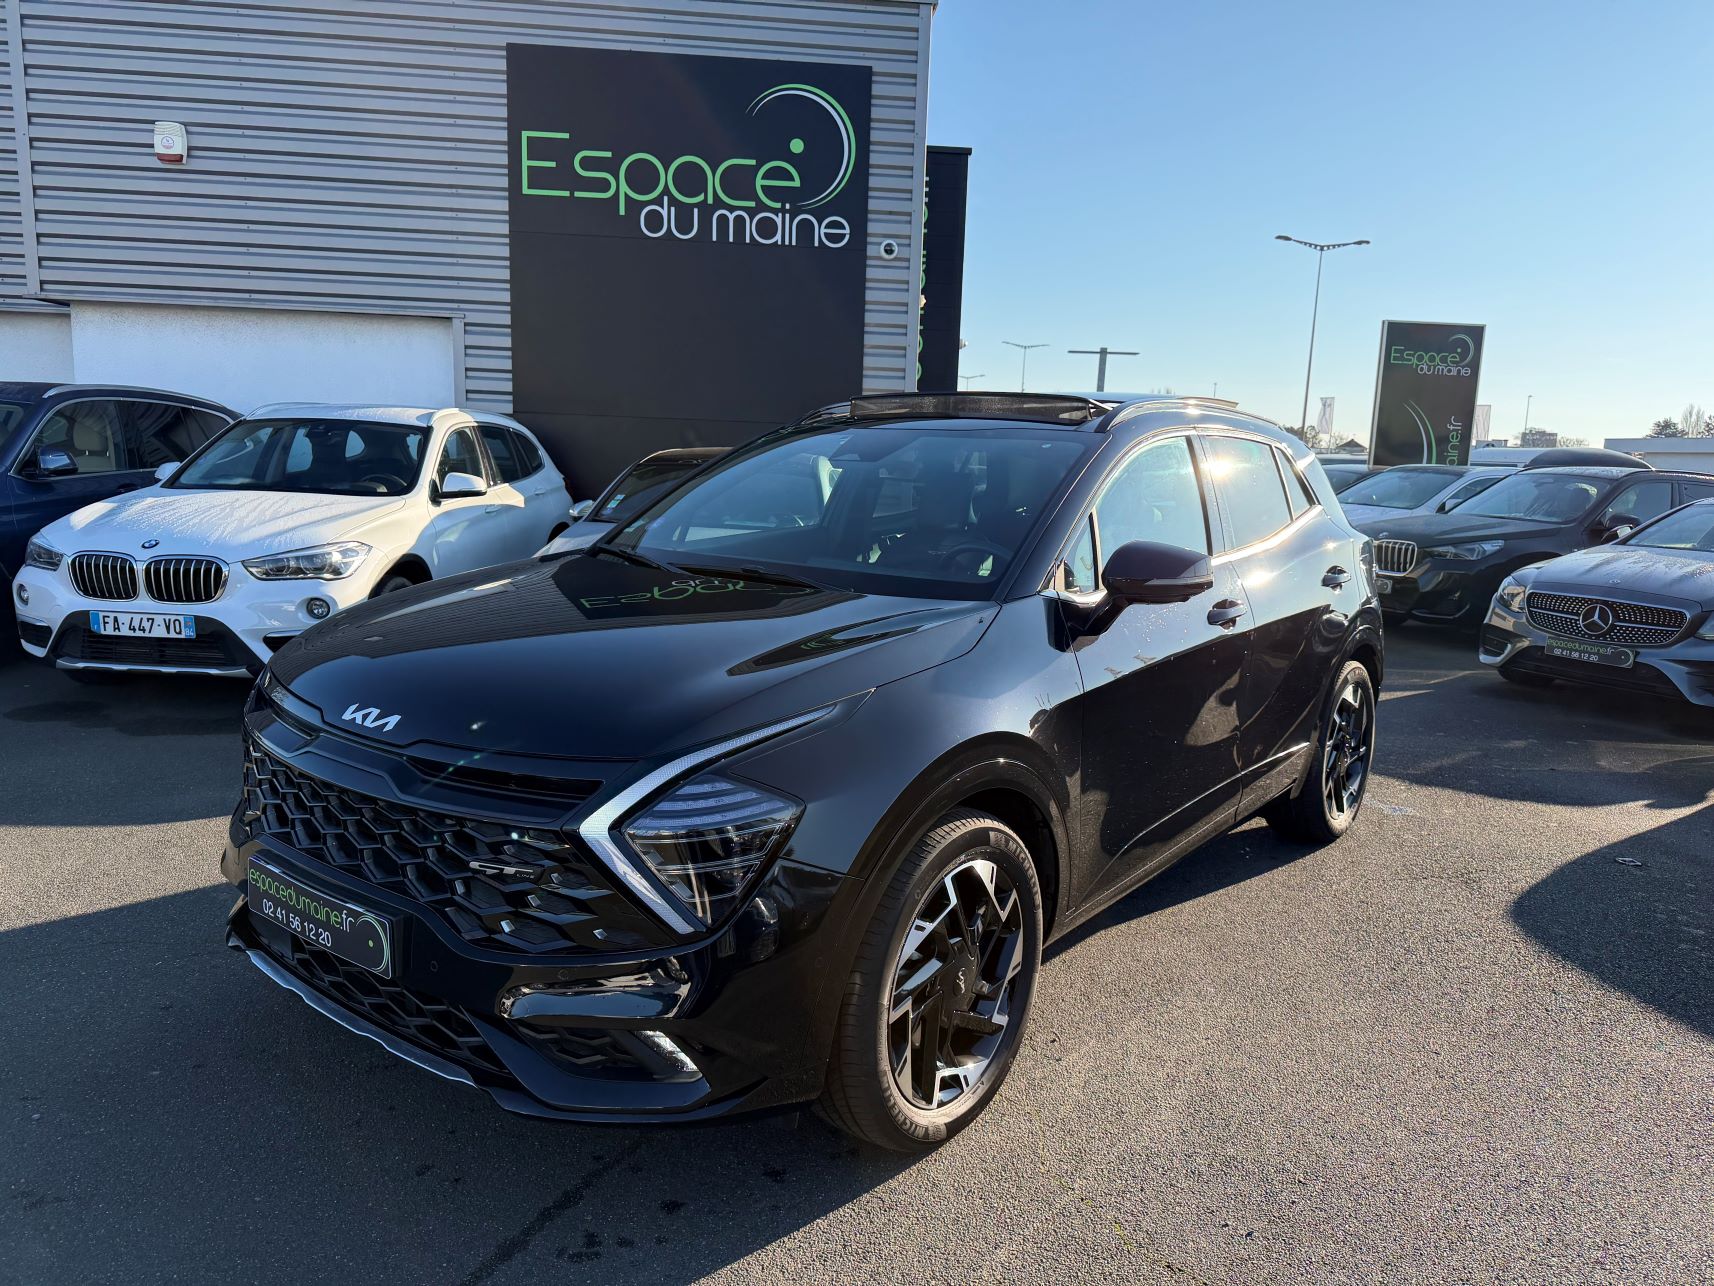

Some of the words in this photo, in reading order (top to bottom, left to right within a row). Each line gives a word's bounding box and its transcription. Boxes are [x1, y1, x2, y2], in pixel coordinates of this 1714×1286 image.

[522, 130, 801, 216] Espace
[640, 195, 698, 240] du
[712, 202, 850, 248] maine
[1390, 345, 1460, 369] Espace
[1417, 363, 1433, 375] du
[1435, 365, 1471, 377] maine
[1547, 638, 1615, 656] espacedumaine.fr
[1562, 649, 1570, 657] 41
[249, 868, 355, 933] espacedumaine.fr
[262, 898, 275, 918] 02
[275, 906, 287, 924] 41
[289, 914, 302, 932] 56
[303, 921, 317, 940] 12
[318, 928, 332, 947] 20
